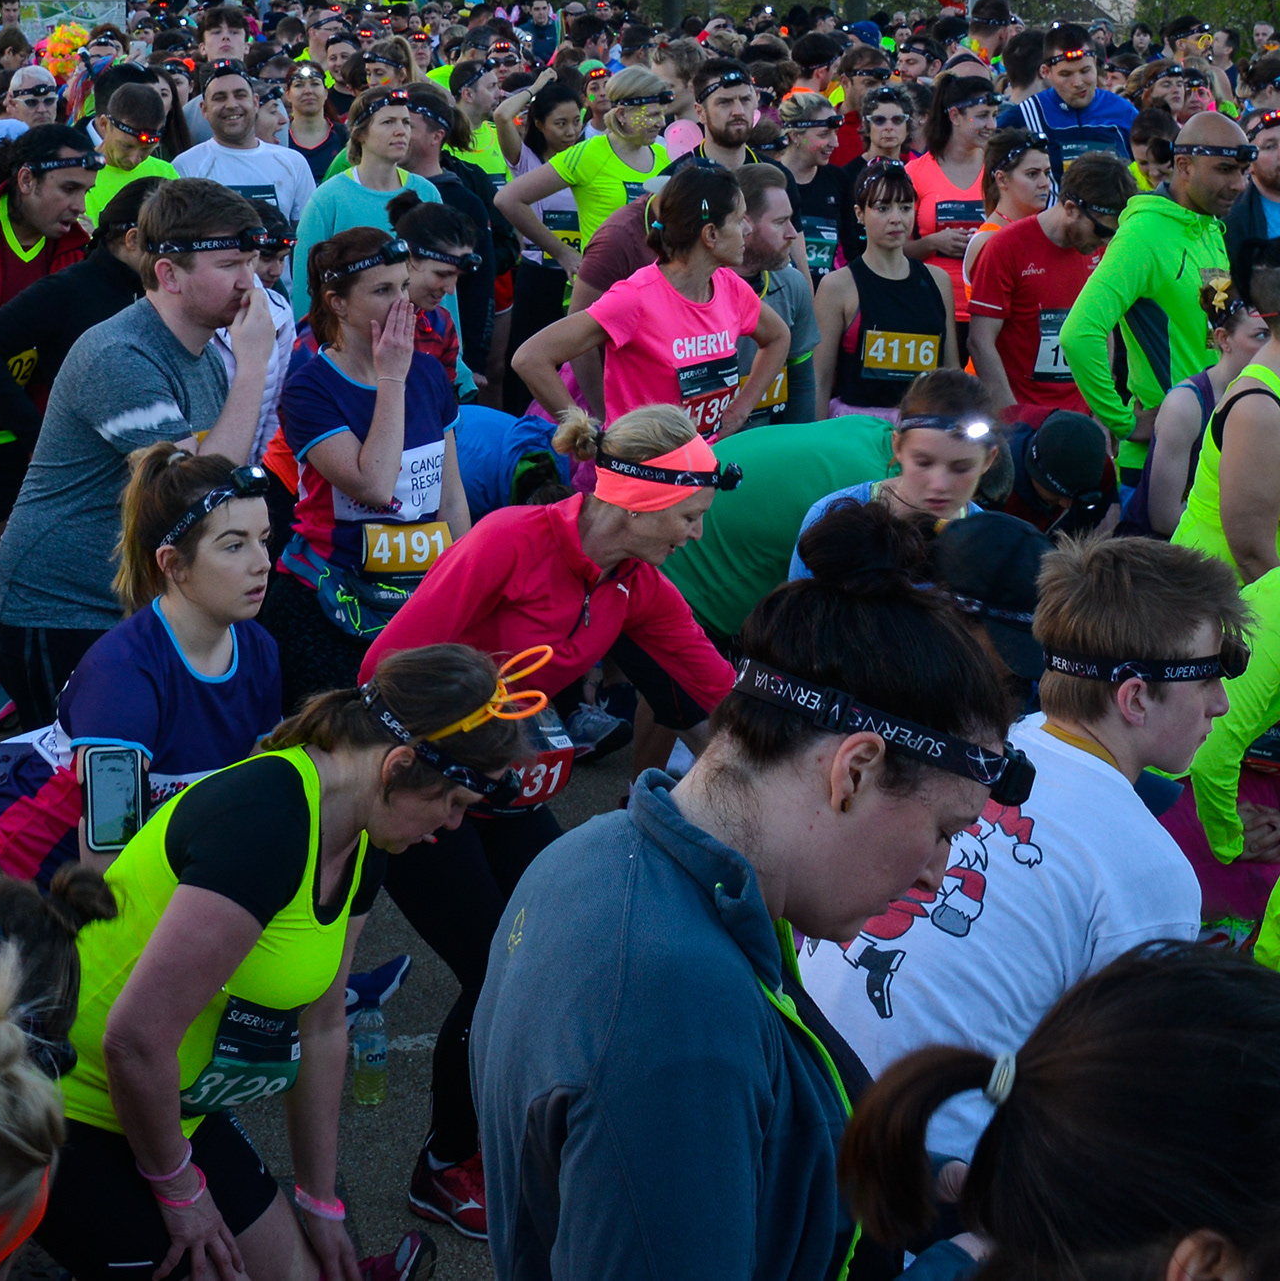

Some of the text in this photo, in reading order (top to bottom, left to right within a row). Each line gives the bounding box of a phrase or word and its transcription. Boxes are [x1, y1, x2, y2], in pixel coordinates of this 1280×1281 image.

[192, 238, 242, 250] SUPERNOV
[673, 331, 735, 361] CHERYL
[867, 337, 935, 367] 4116
[611, 459, 667, 481] SUPERNOVA
[371, 531, 445, 564] 4191
[221, 1009, 280, 1034] SUPERNOVA
[193, 1074, 287, 1106] 3128
